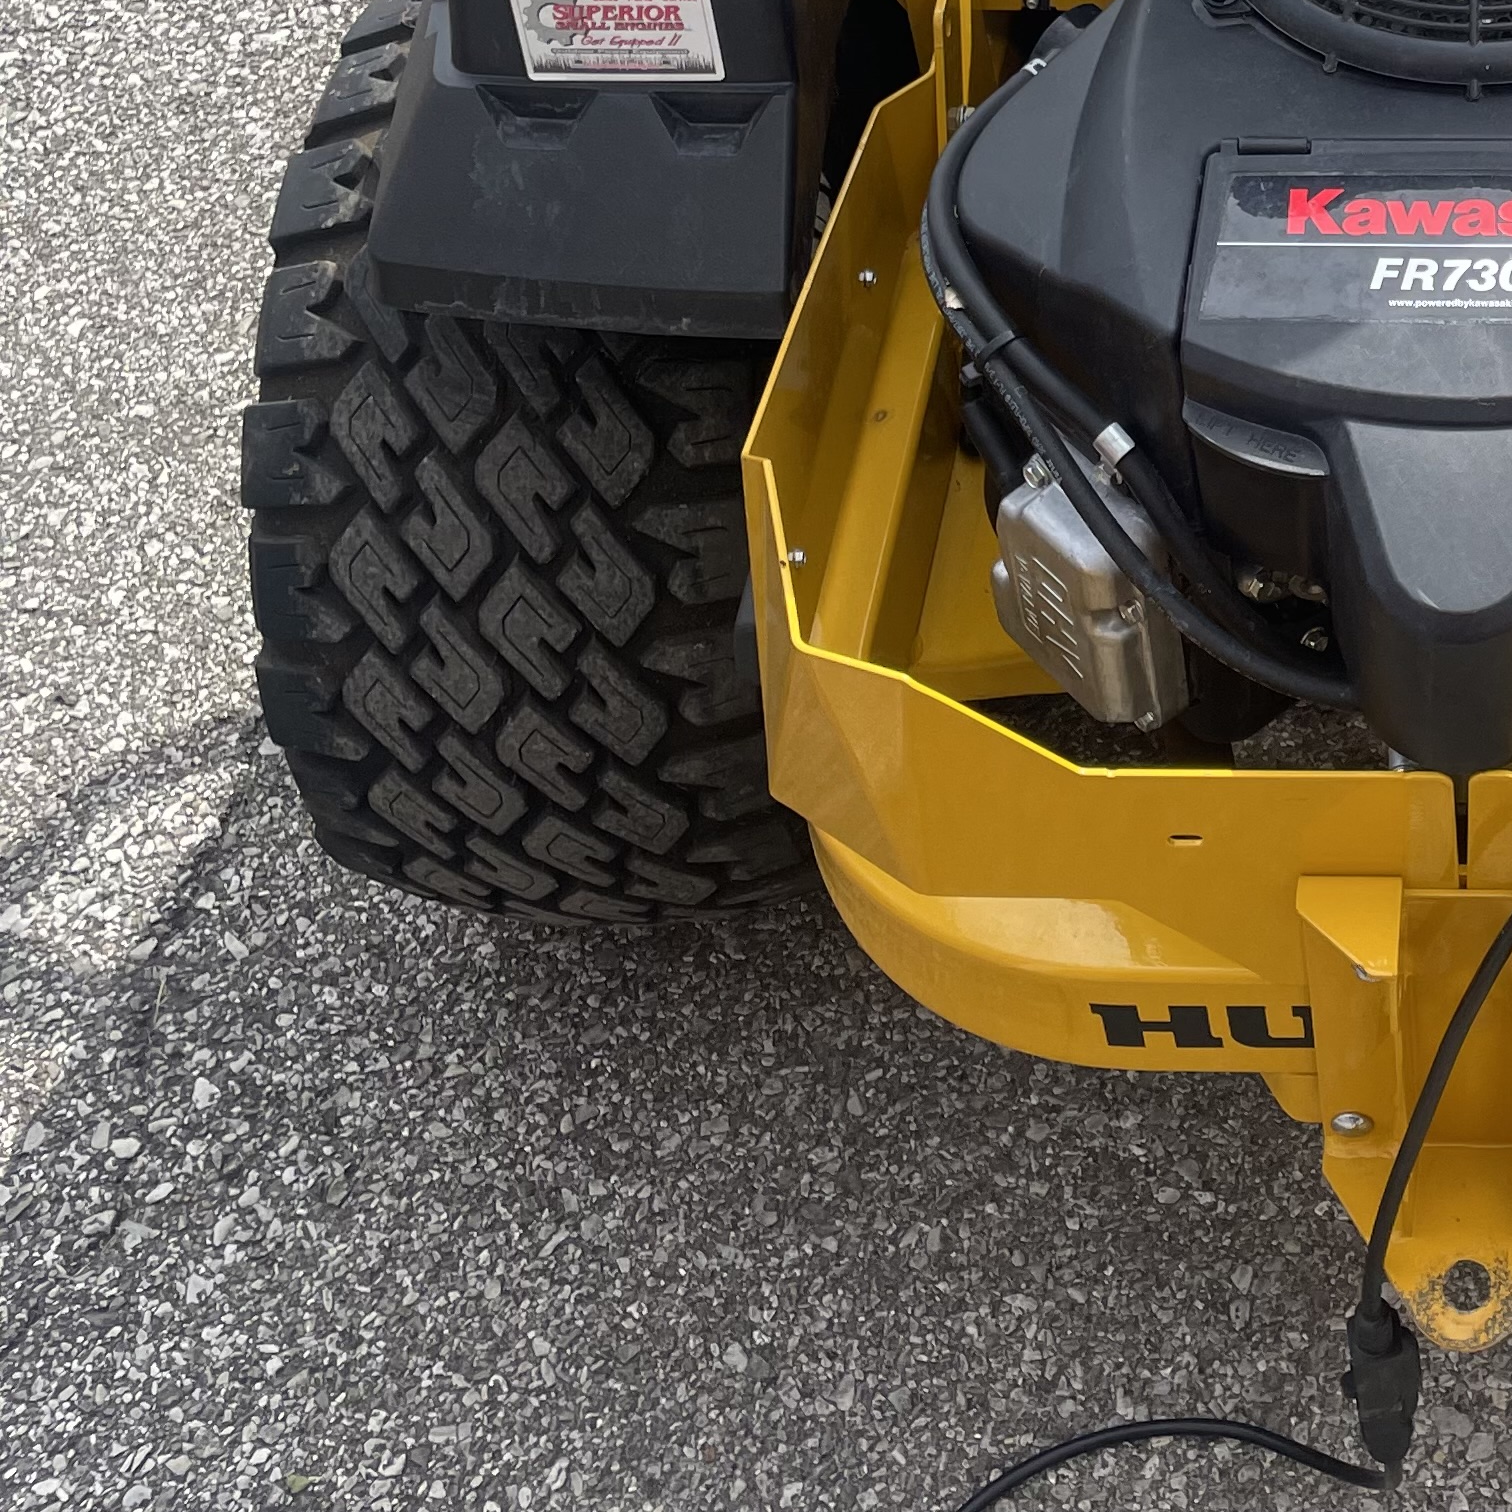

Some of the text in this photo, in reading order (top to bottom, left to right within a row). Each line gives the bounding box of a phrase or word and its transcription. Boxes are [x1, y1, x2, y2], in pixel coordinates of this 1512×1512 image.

[552, 4, 681, 21] SUPERIOR
[555, 22, 684, 31] SMALL ENGINES
[1246, 431, 1300, 463] HERE
